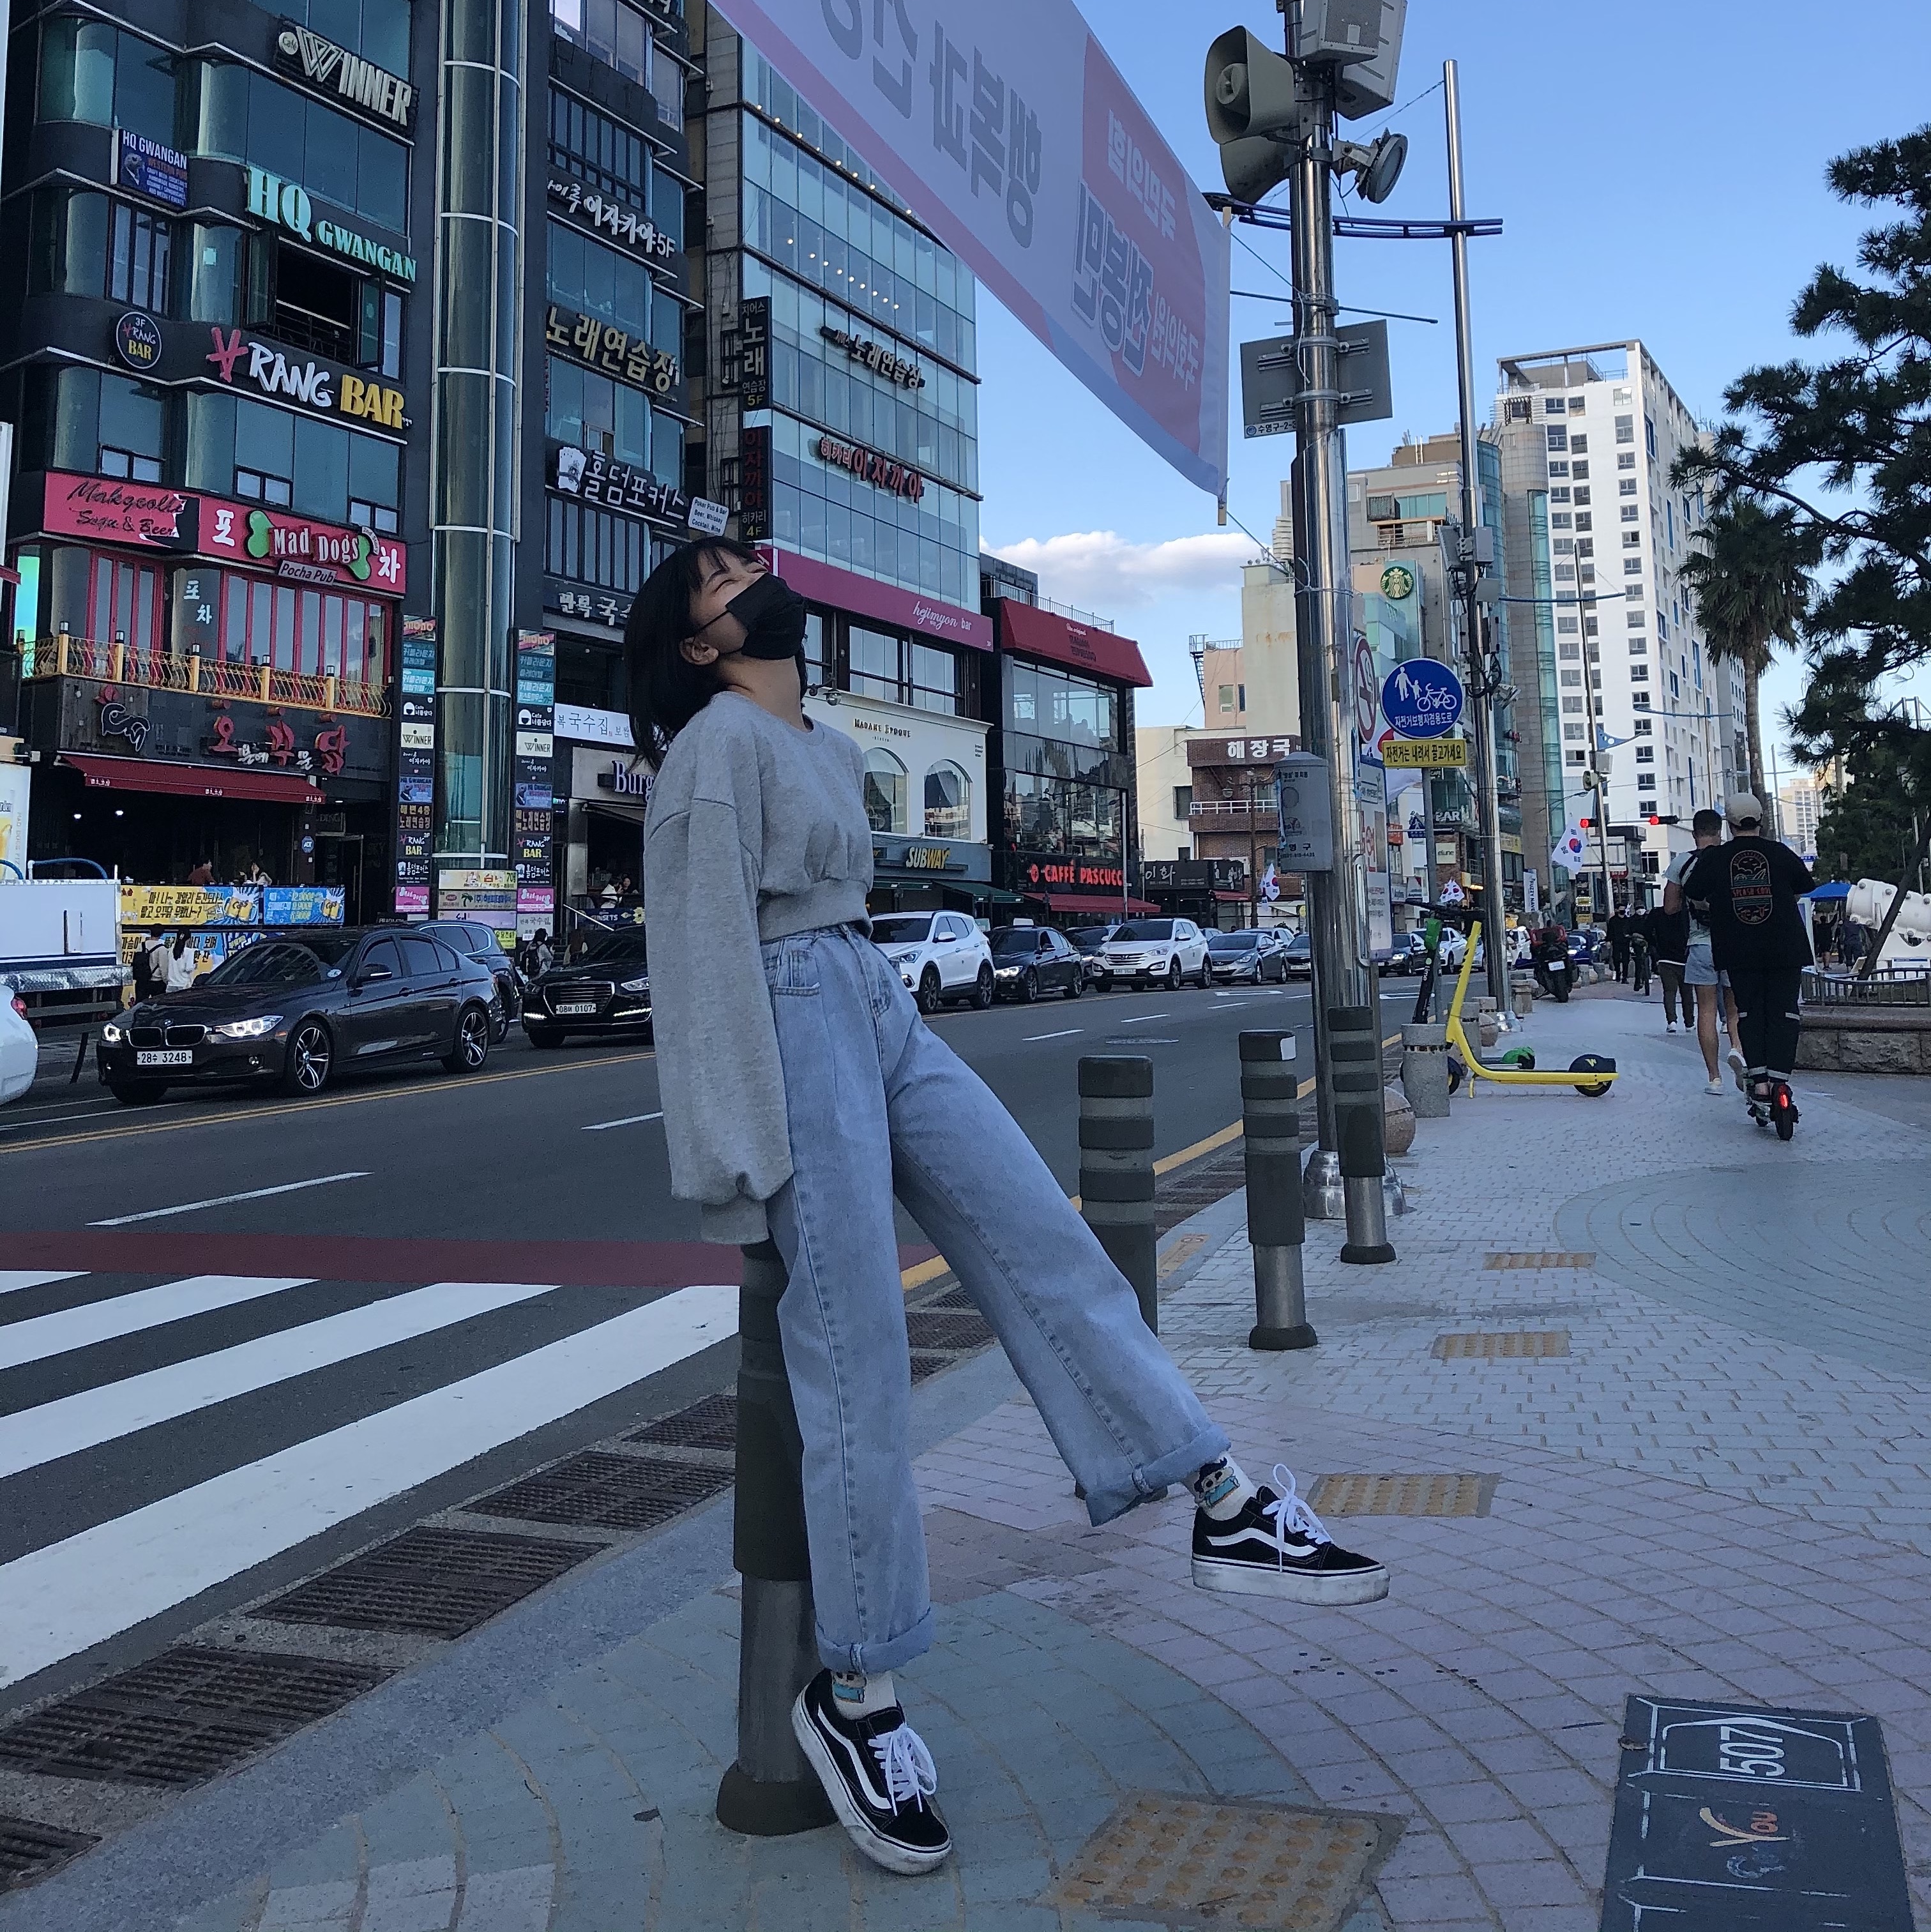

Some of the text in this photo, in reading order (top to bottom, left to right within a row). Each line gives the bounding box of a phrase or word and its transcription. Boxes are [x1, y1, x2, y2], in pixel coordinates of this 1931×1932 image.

[296, 26, 412, 126] WINNER
[123, 130, 187, 170] HQ GWANGAN
[246, 165, 312, 243] HQ
[316, 220, 416, 282] GWANGAN
[656, 232, 676, 258] 5F
[741, 301, 766, 316] 치어스
[135, 317, 146, 328] 3F
[128, 339, 152, 361] BAR
[547, 306, 672, 393] 노래연습장
[743, 317, 765, 376] 노래
[851, 334, 923, 389] 노래연습장
[742, 379, 766, 394] 연습장
[340, 374, 404, 430] BAR
[747, 395, 764, 406] 5F
[820, 436, 923, 504] 히카리 이자까야
[584, 450, 685, 520] 홀덤포커스
[742, 509, 766, 525] 히카리
[273, 528, 310, 555] Mad
[746, 525, 762, 537] 4F
[280, 563, 335, 584] Pocha Pub
[961, 617, 972, 631] bar
[568, 712, 609, 736] 국수집
[854, 718, 882, 733] MADAME
[1395, 712, 1453, 728] 자전거보행자겸용도로
[402, 734, 432, 745] WINNER
[524, 742, 551, 753] WINNER
[1227, 738, 1291, 759] 해장국
[1386, 743, 1462, 763] 자전거는 내려서 끌고가세요
[399, 816, 431, 830] 노래연습장
[522, 810, 551, 832] 노래연습장
[405, 845, 422, 855] BAR
[524, 848, 542, 858] BAR
[905, 846, 950, 869] SUBWAY
[406, 861, 429, 876] 홀덤포커스
[526, 864, 550, 879] 홀덤포커스
[1080, 866, 1125, 887] PASCUCC
[1145, 864, 1176, 886] 이화
[575, 1004, 593, 1012] 0107
[141, 1051, 187, 1063] 28수 3248
[1720, 1725, 1785, 1777] 507
